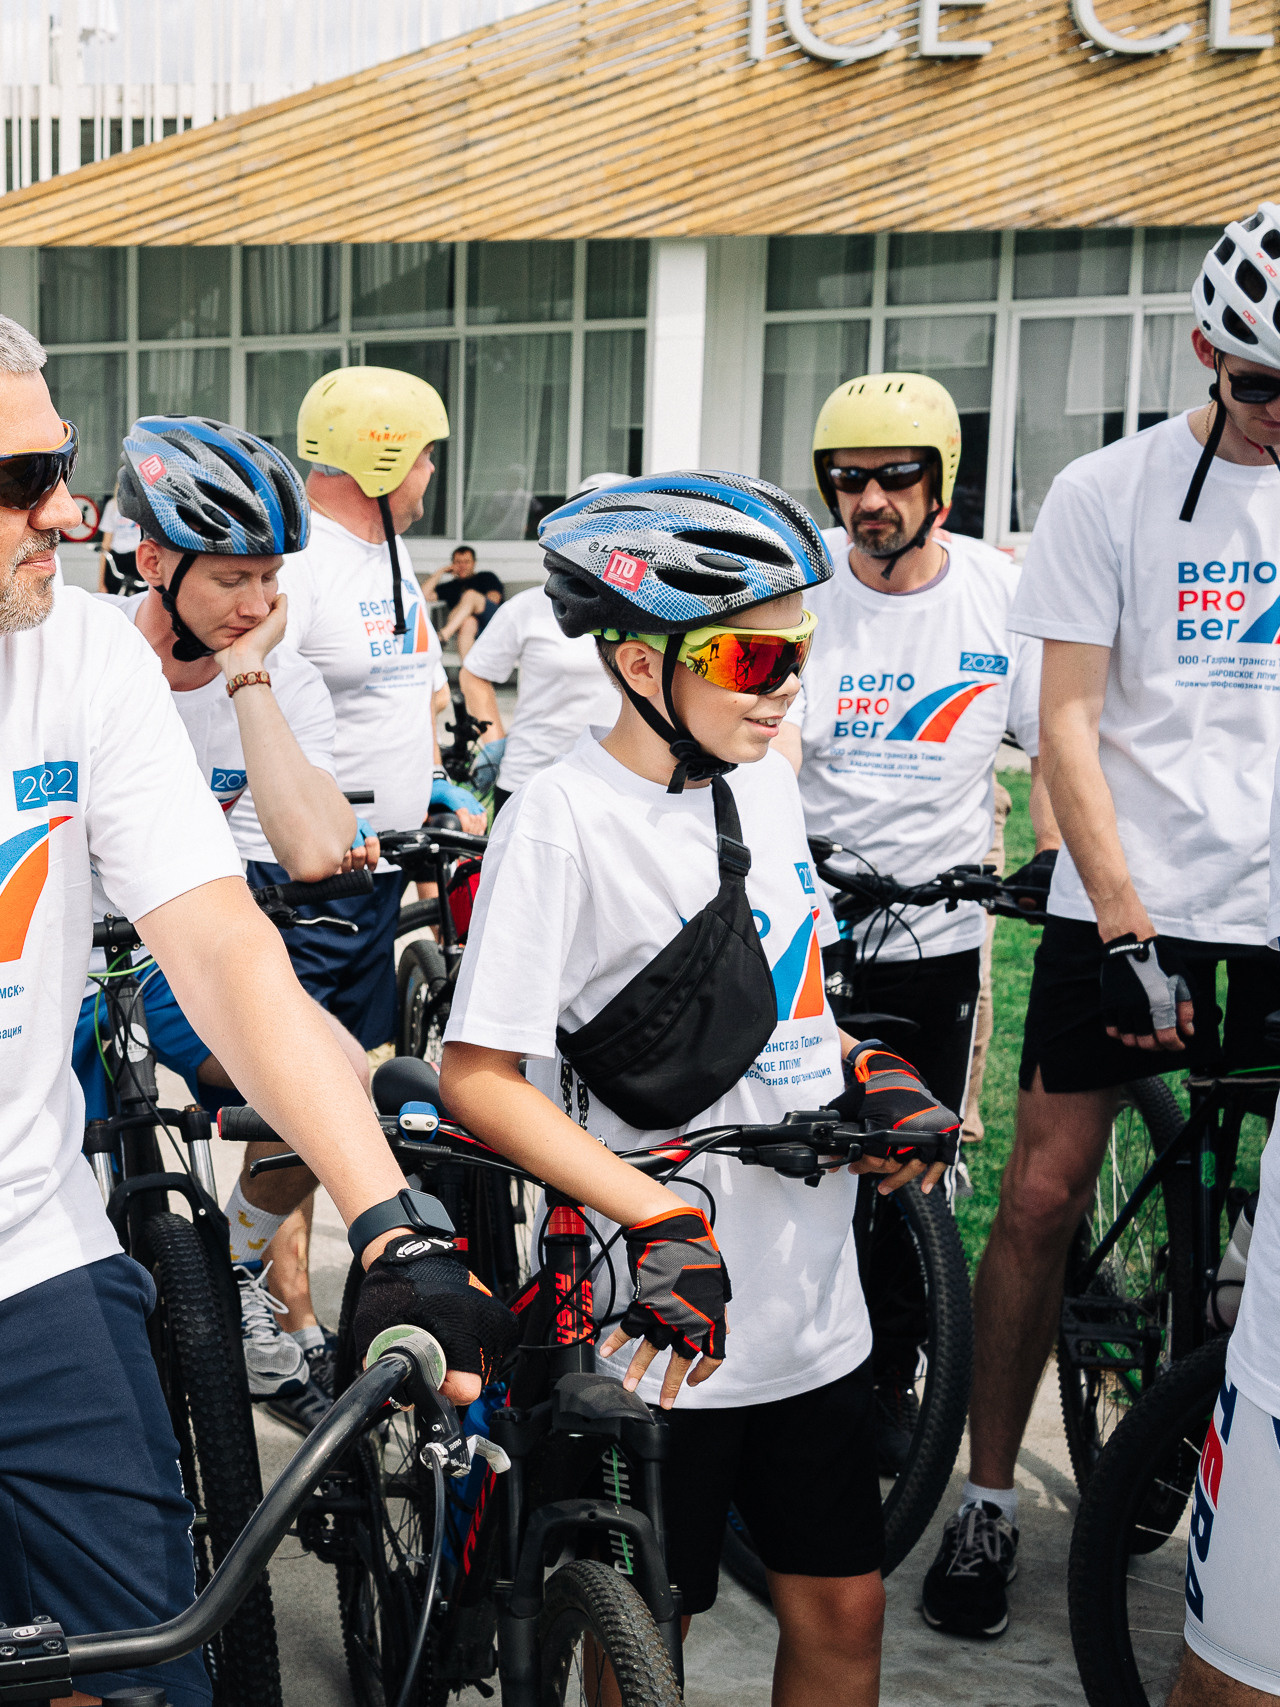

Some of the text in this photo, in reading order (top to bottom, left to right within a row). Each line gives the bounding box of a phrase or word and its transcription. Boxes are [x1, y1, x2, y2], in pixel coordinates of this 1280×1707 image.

[1178, 590, 1246, 612] PRO
[963, 654, 1007, 674] 2022
[837, 698, 889, 716] PRO
[214, 772, 247, 788] 20
